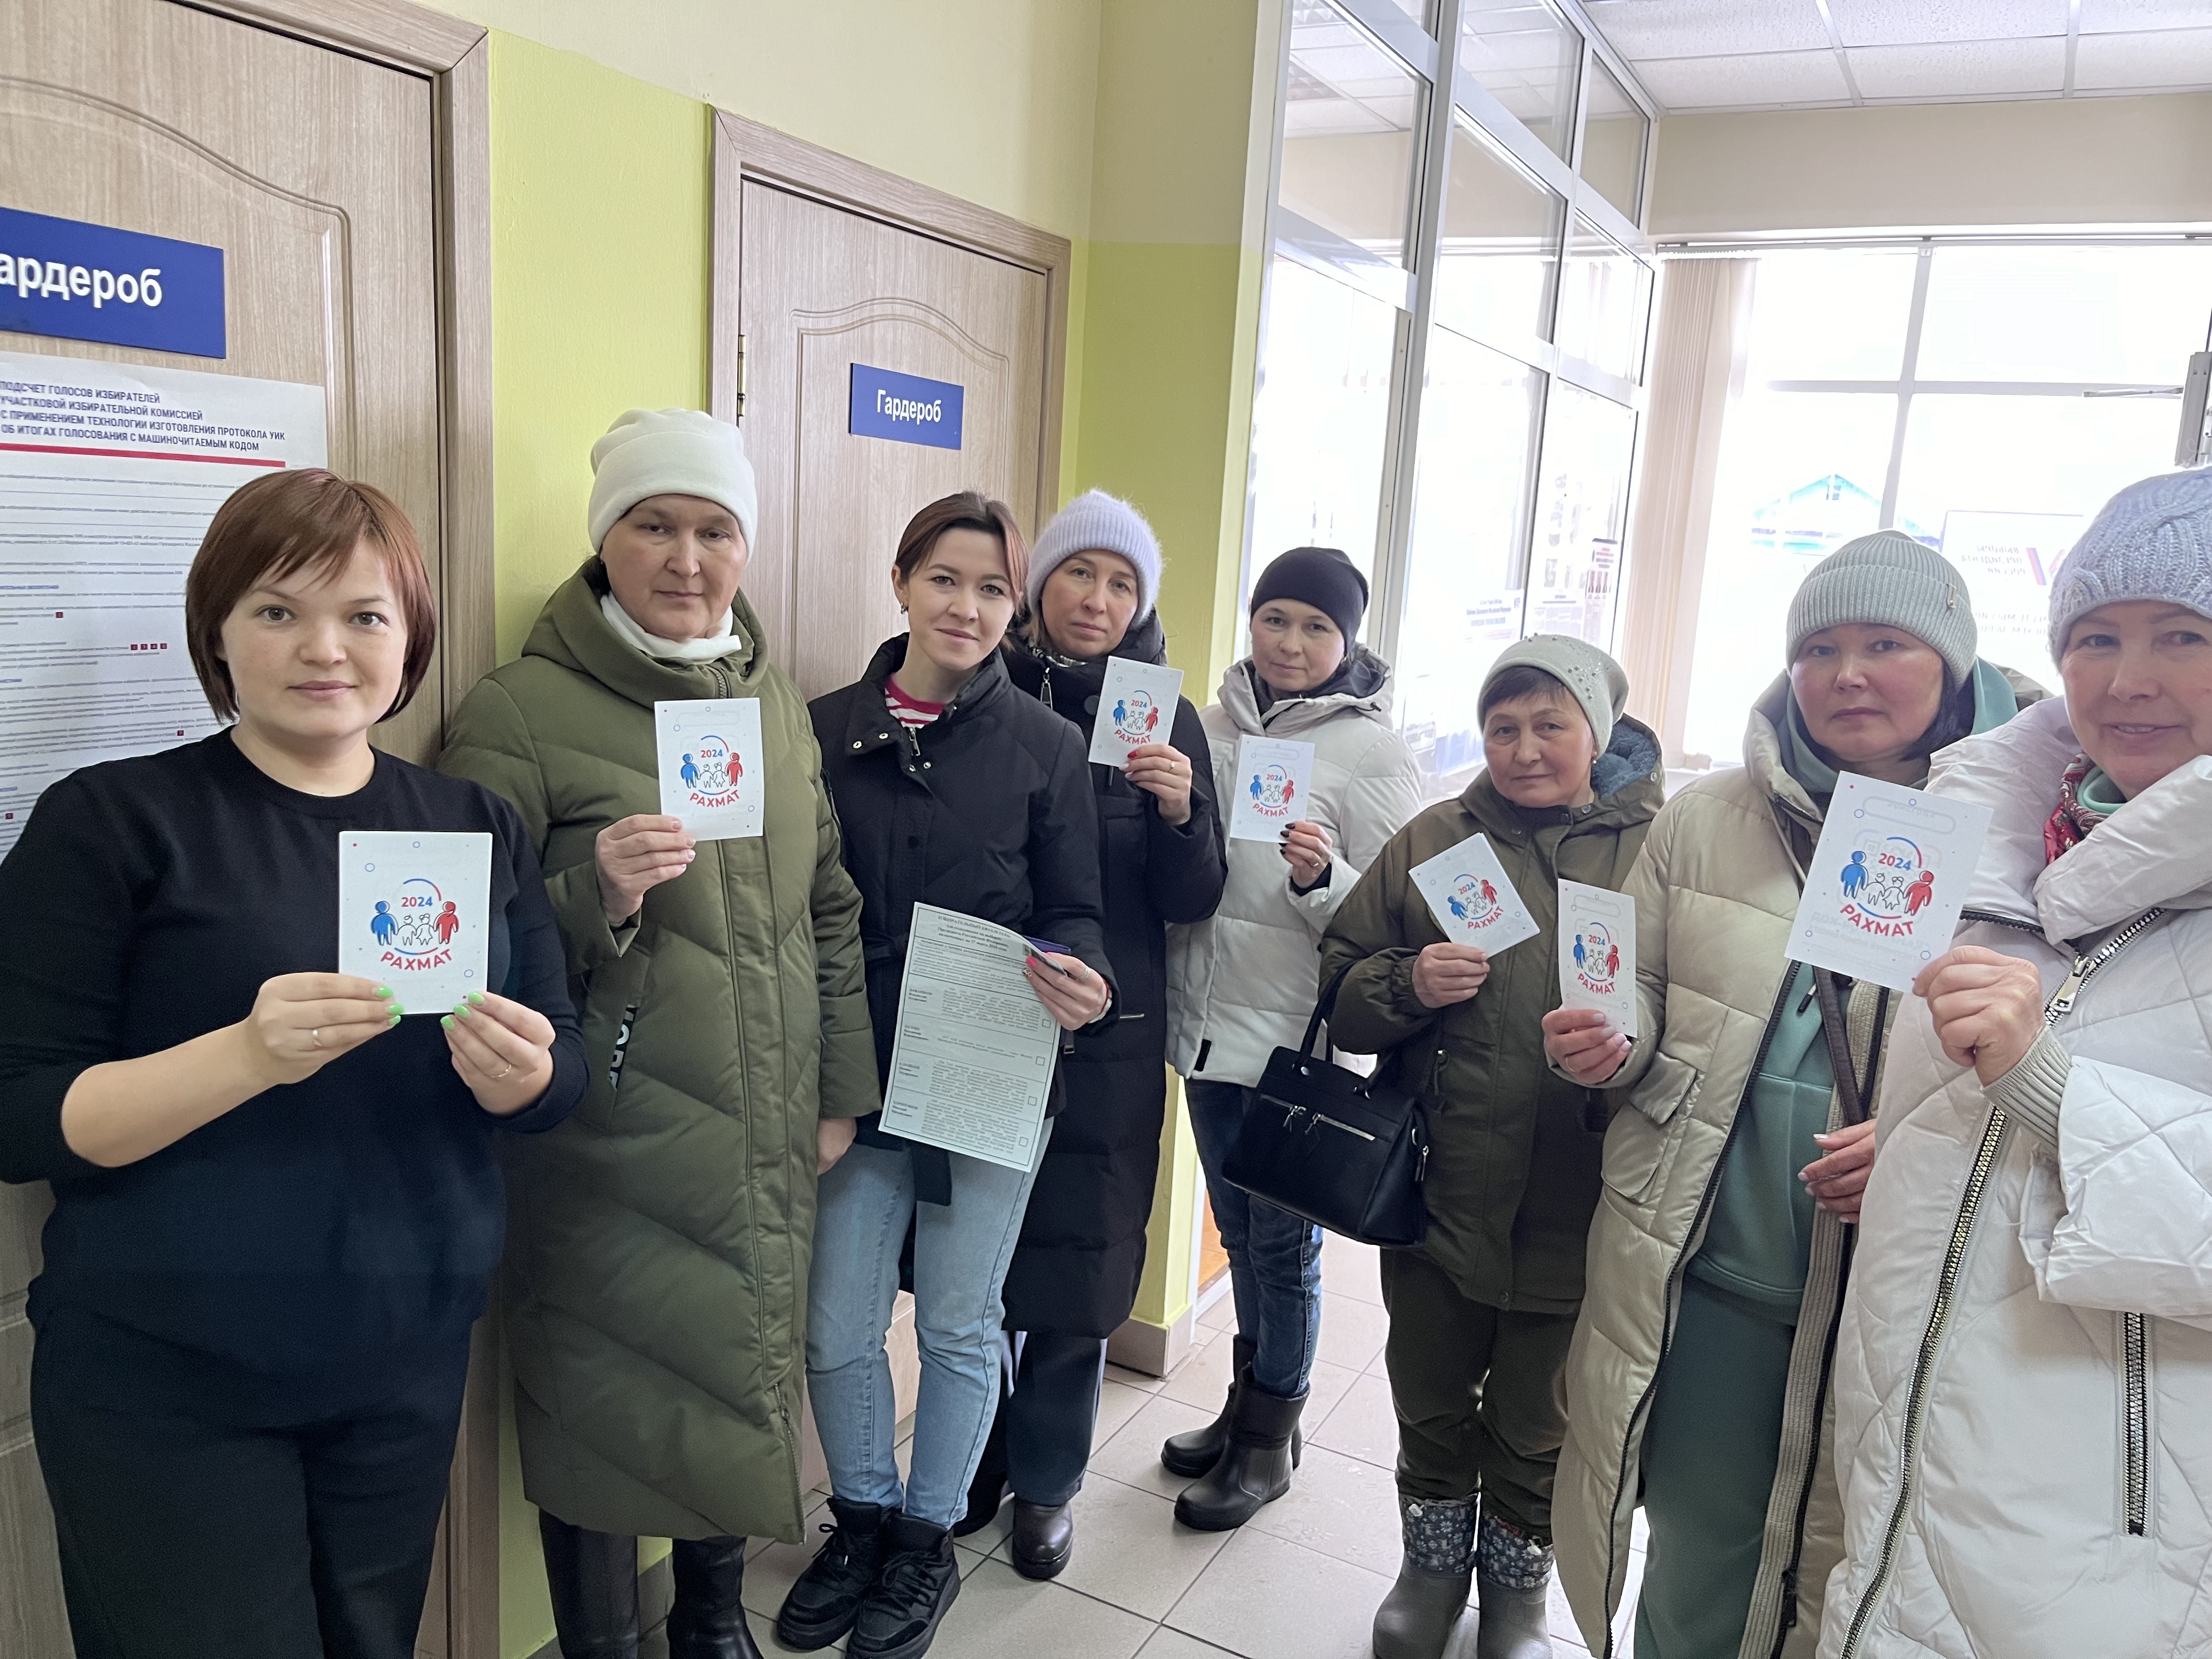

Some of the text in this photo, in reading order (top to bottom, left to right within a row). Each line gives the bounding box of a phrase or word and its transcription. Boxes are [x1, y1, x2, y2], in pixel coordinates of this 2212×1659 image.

[0, 253, 162, 308] ардероб
[49, 386, 93, 397] ГОЛОСОВ
[95, 390, 160, 403] ИЗБИРАТЕЛЕЙ
[0, 396, 203, 421] УЧАСТКОВОЙ ИЗБИРАТЕЛЬНОЙ КОМИССИЕЙ
[877, 389, 941, 425] Гардероб
[1, 410, 285, 440] С ПРИМЕНЕНИЕМ ТЕХНОЛОГИИ ИЗГОТОВЛЕНИЯ ПРОТОКОЛА УИК
[1, 424, 259, 452] ОБ ИТОГАХ ГОЛОСОВАНИЯ С МАШИНОЧИТАЕМЫМ КОДОМ
[1114, 729, 1150, 744] РАХМАТ
[701, 749, 723, 758] 2024
[690, 790, 740, 807] РАХМАТ
[1252, 803, 1289, 817] РАХМАТ
[1878, 853, 1911, 871] 2024
[1458, 882, 1475, 894] 2024
[401, 896, 433, 907] 2024
[1468, 906, 1504, 929] РАХМАТ
[1839, 904, 1914, 936] РАХМАТ
[1589, 935, 1605, 945] 2024
[380, 949, 452, 970] РАХМАТ
[1577, 973, 1615, 994] РАХМАТ
